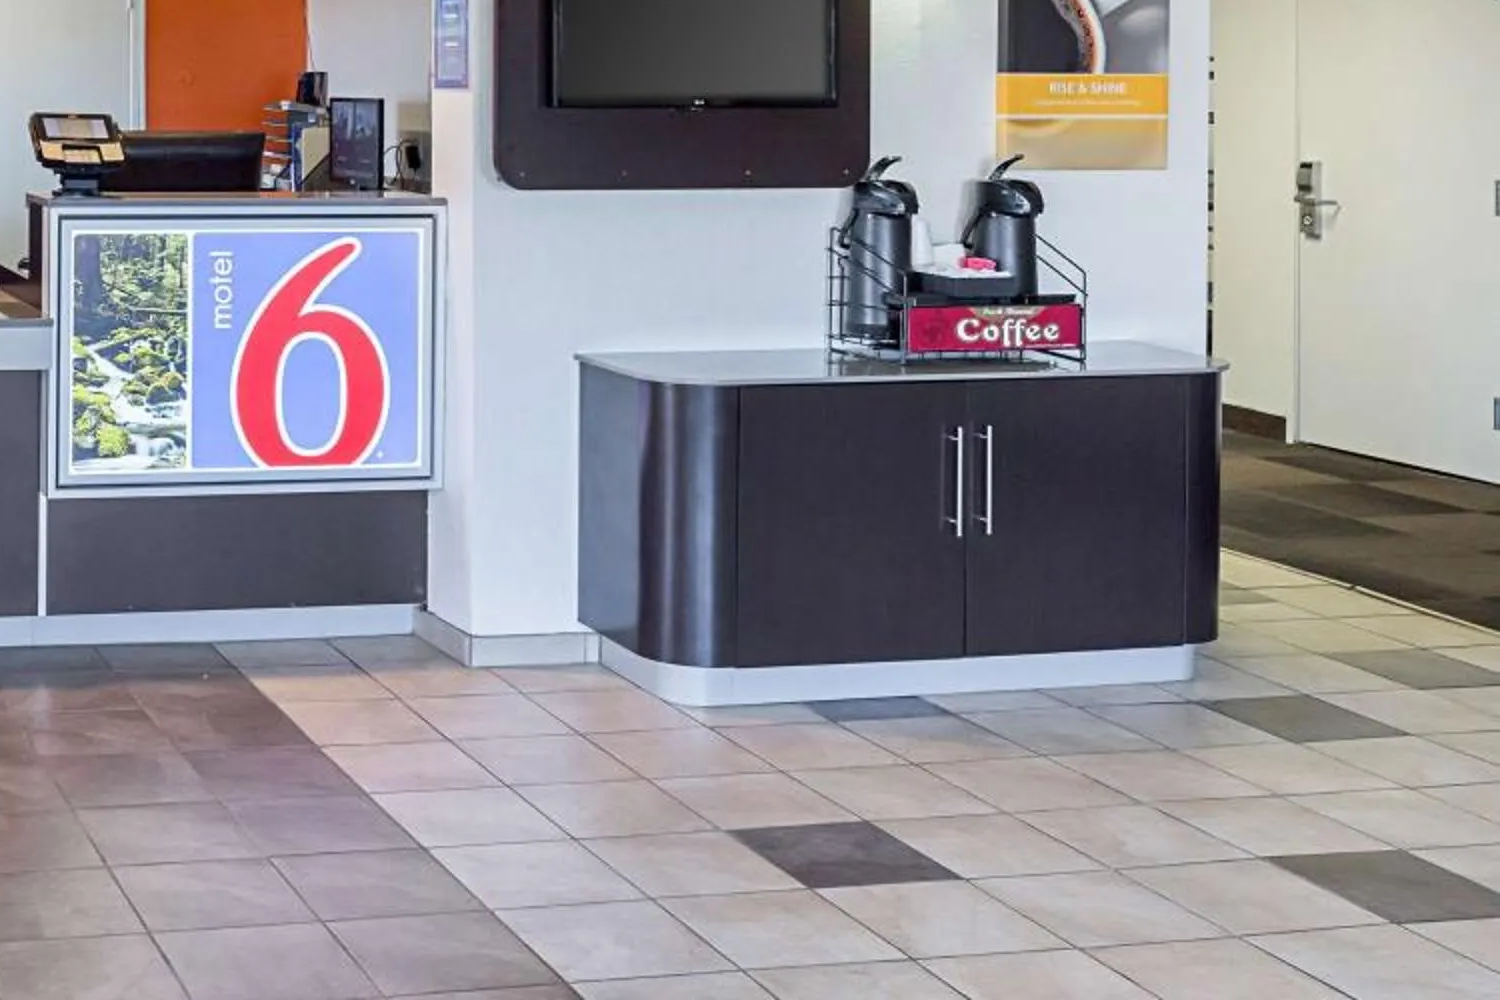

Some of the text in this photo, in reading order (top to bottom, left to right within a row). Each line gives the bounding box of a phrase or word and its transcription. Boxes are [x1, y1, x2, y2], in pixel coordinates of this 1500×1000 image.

[208, 251, 233, 329] motel
[230, 236, 391, 468] 6
[956, 318, 1060, 347] Coffee
